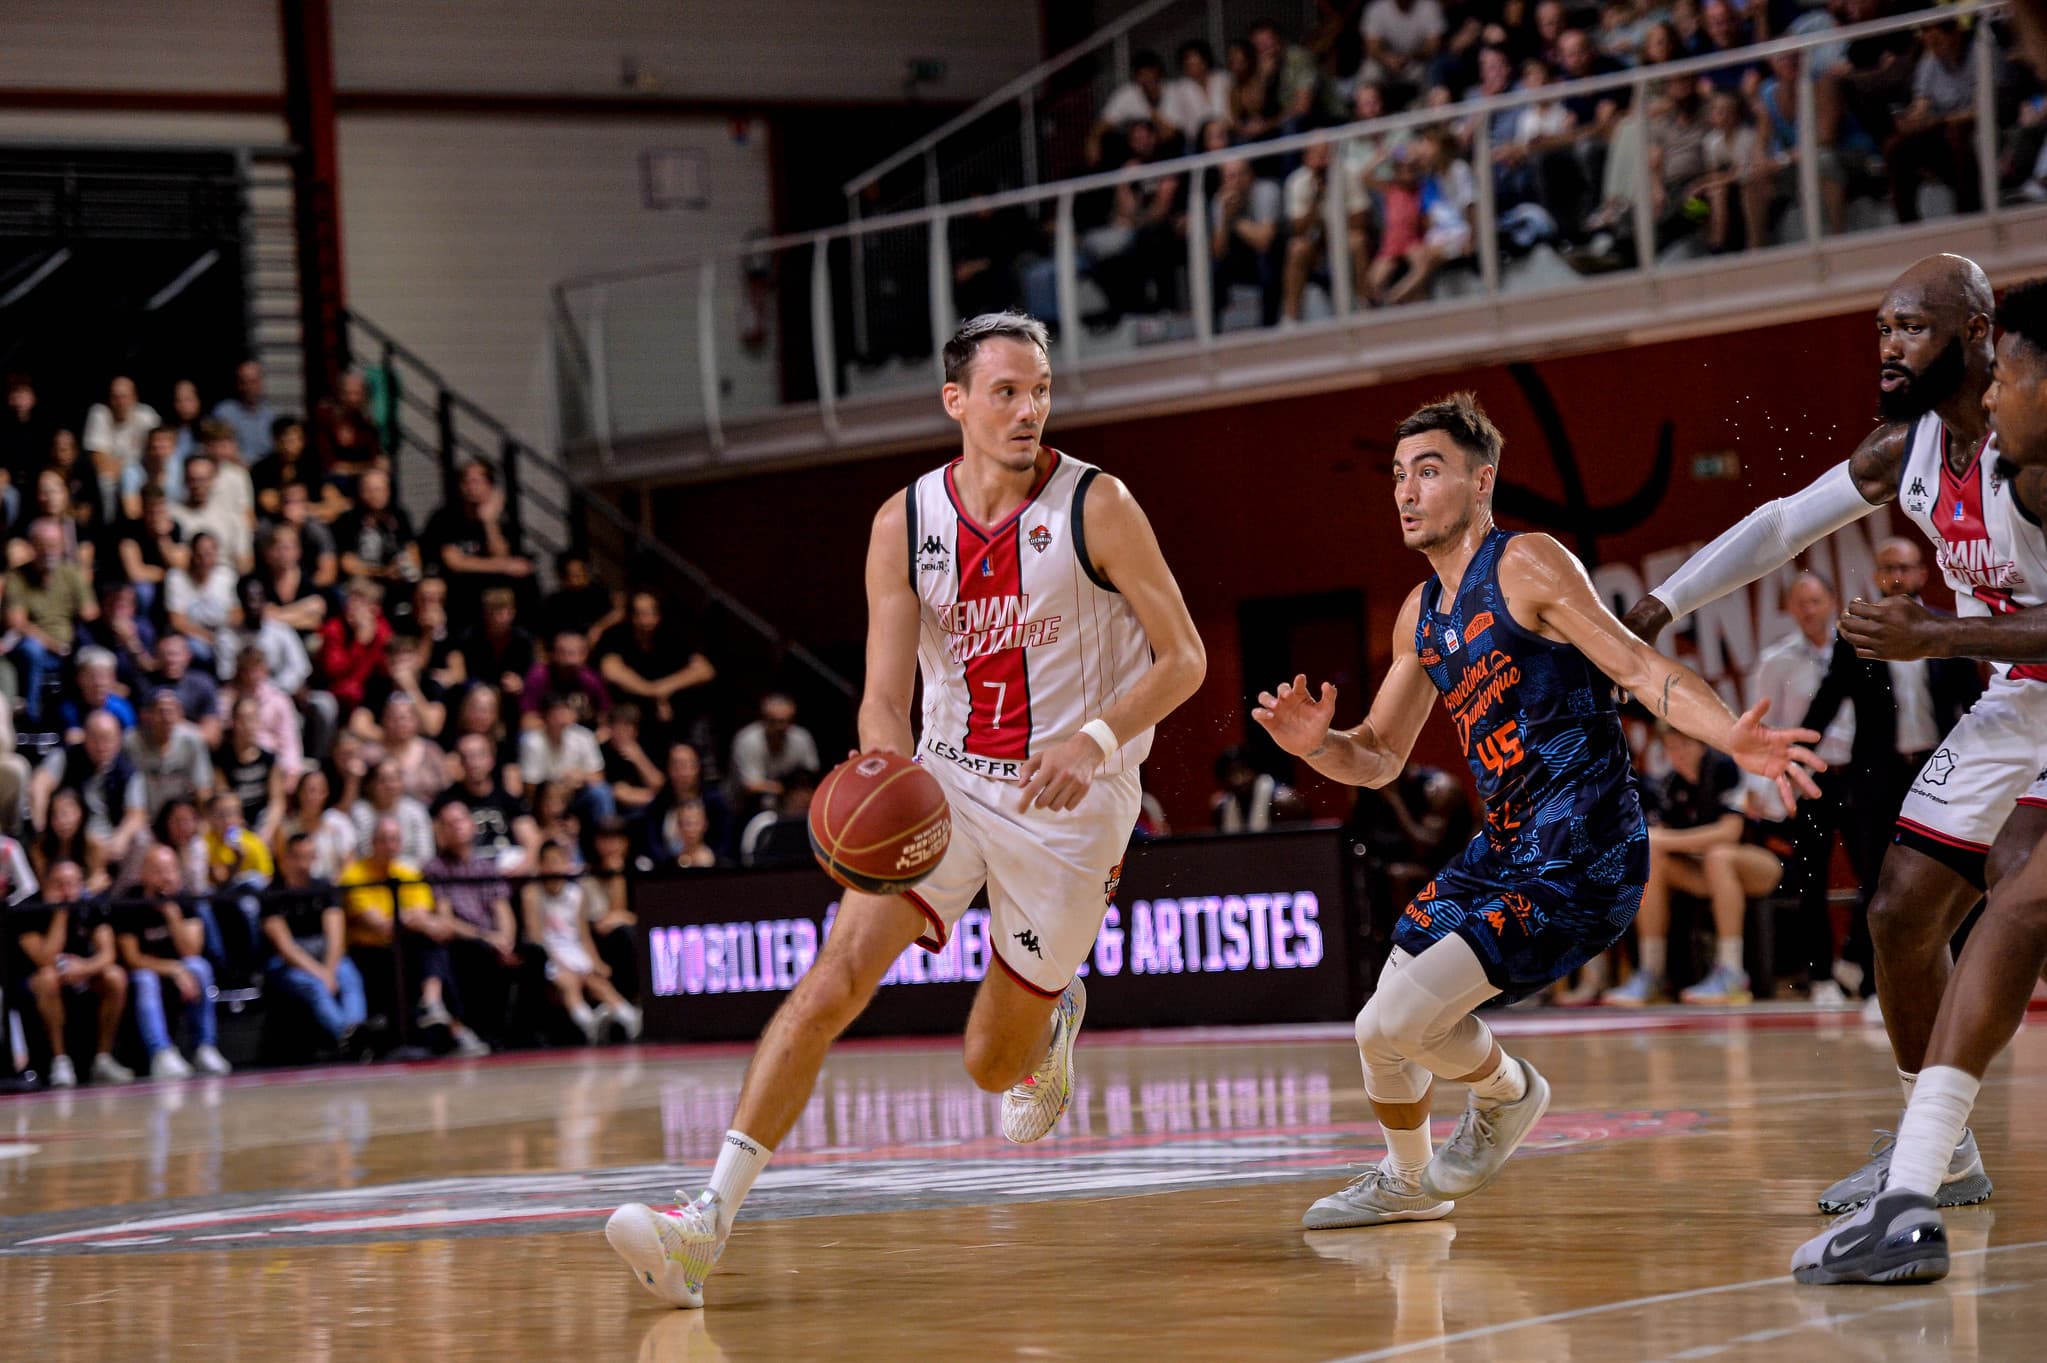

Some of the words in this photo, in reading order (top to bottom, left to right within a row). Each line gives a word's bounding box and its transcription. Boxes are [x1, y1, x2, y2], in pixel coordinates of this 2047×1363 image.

[938, 594, 1029, 634] DENAIN
[950, 616, 1061, 664] VOLTAIRE
[983, 681, 1006, 729] 7
[1454, 666, 1520, 757] Dunkerque
[927, 739, 1023, 777] LESAFFR
[1476, 720, 1524, 776] 45
[649, 918, 818, 996] MOBILIER
[1130, 889, 1323, 976] ARTISTES
